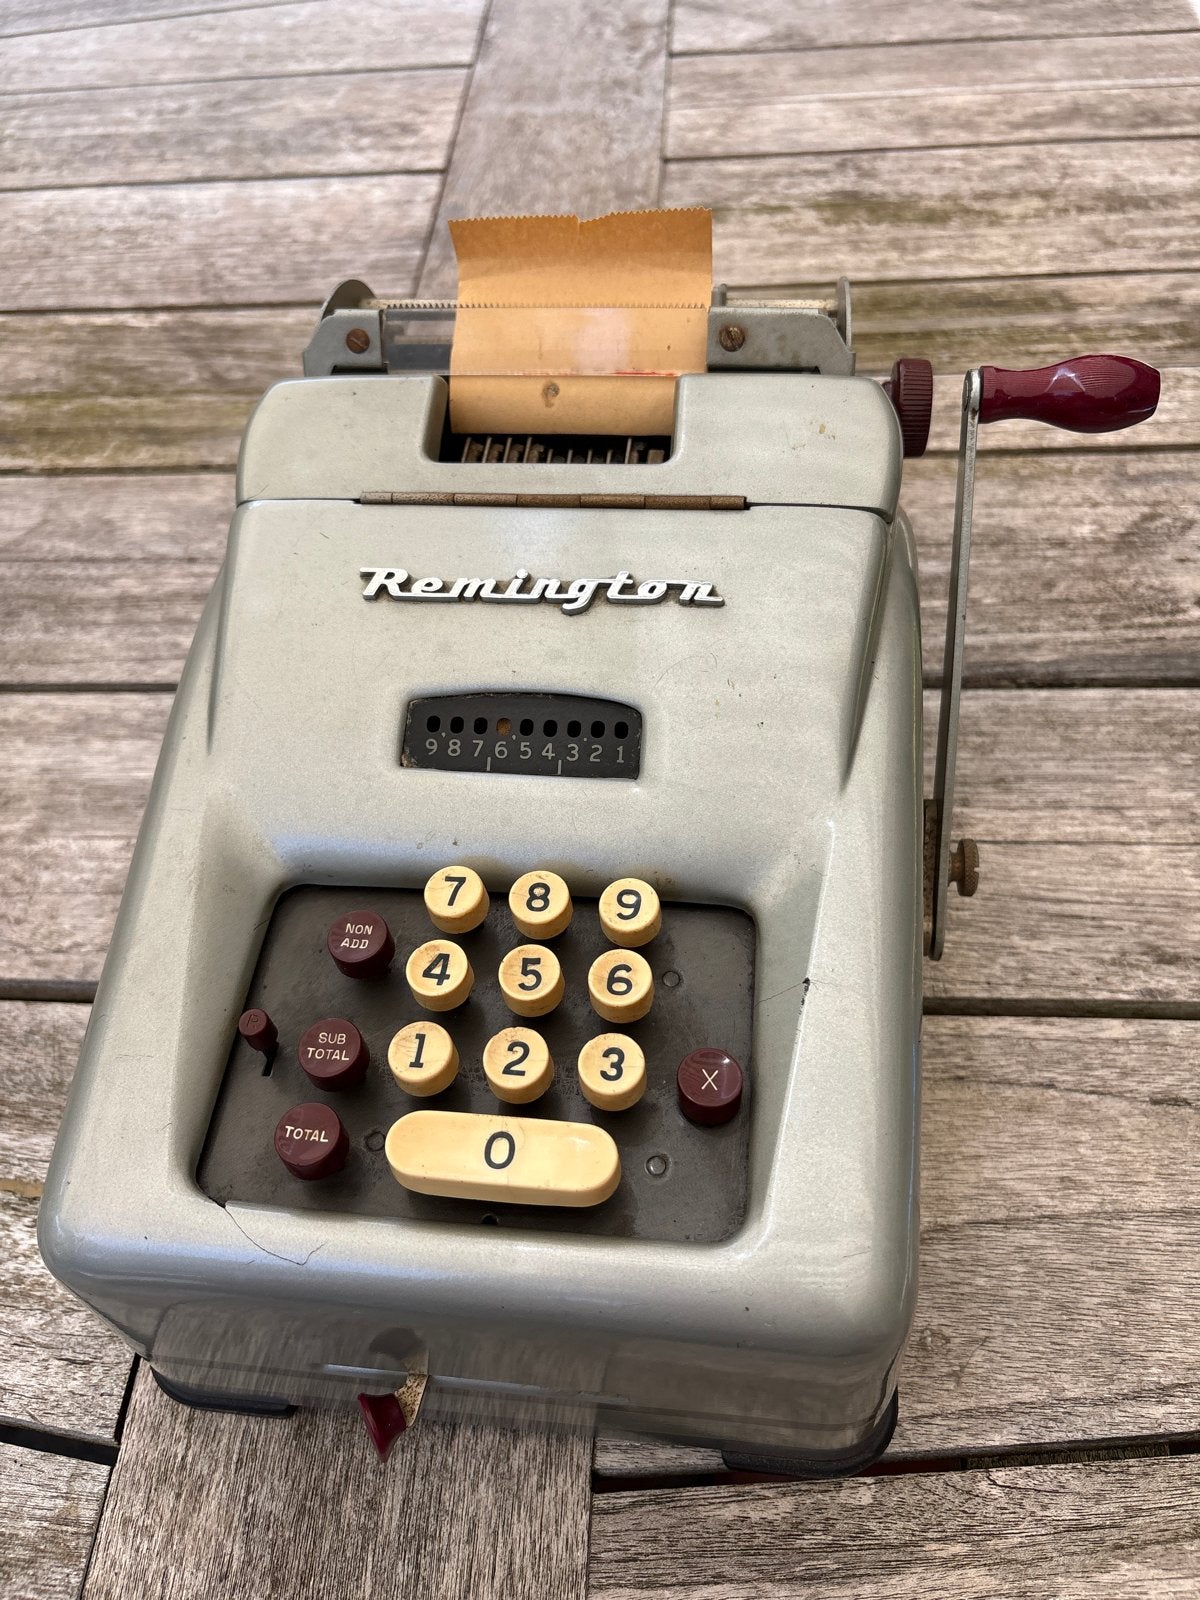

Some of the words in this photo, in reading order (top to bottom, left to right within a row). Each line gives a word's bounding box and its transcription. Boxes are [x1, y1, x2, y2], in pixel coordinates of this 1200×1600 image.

[360, 567, 724, 615] Remington
[425, 738, 438, 755] 9
[447, 739, 461, 757] 8
[472, 740, 484, 757] 7
[494, 741, 508, 759] 6
[519, 742, 532, 760] 5
[541, 743, 556, 760] 4
[566, 743, 580, 762] 3
[589, 745, 602, 763] 2
[616, 746, 625, 763] 1
[444, 876, 467, 906] 7
[525, 883, 551, 912] 8
[616, 889, 642, 920] 9
[345, 922, 374, 935] NON
[340, 937, 370, 949] ADD
[422, 953, 450, 986] 4
[518, 957, 543, 991] 5
[606, 963, 633, 996] 6
[318, 1032, 347, 1045] SUB
[307, 1047, 350, 1061] TOTAL
[408, 1033, 427, 1069] 1
[502, 1041, 530, 1076] 2
[600, 1047, 625, 1082] 3
[701, 1068, 719, 1091] X
[284, 1125, 329, 1142] TOTAL
[484, 1131, 516, 1170] 0
